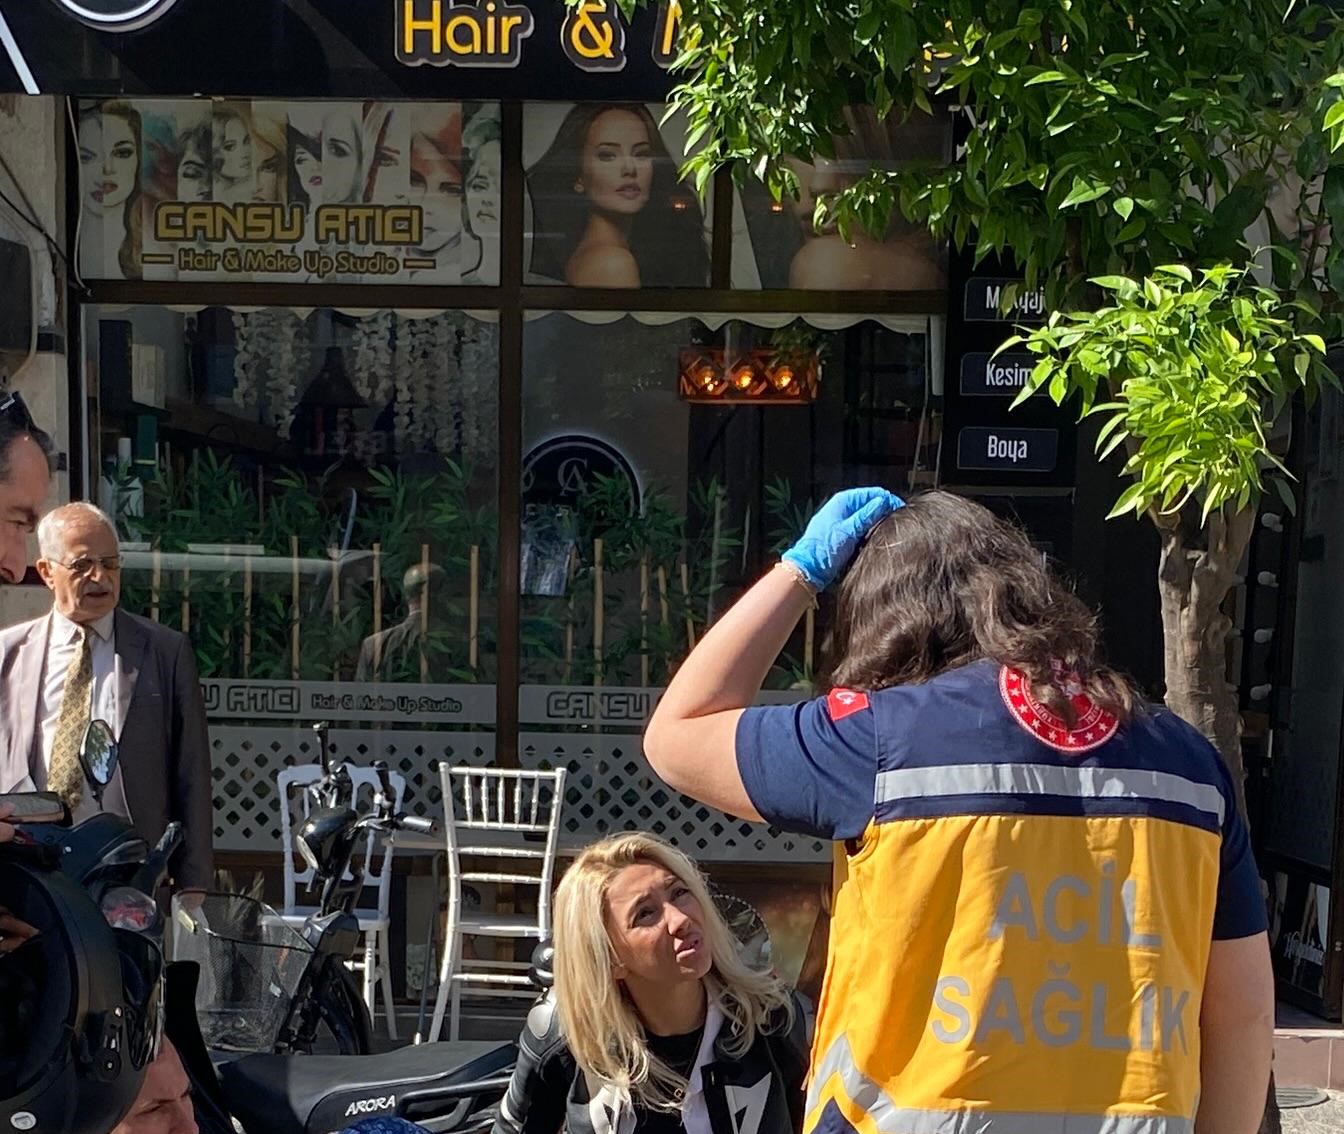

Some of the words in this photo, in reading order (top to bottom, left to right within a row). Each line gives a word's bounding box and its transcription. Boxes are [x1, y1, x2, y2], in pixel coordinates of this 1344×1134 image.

[404, 0, 523, 54] Hair
[155, 202, 303, 243] CANSU
[179, 249, 219, 273] Hair
[223, 251, 240, 272] &
[245, 251, 301, 273] Make
[304, 252, 334, 277] Up
[335, 252, 399, 274] Studio
[986, 286, 1045, 315] Myaj
[987, 435, 1028, 463] Boya
[547, 691, 650, 720] CANSU
[986, 859, 1163, 948] ACİL
[931, 958, 1191, 1056] SAĞLIK
[345, 1095, 396, 1117] ARORA
